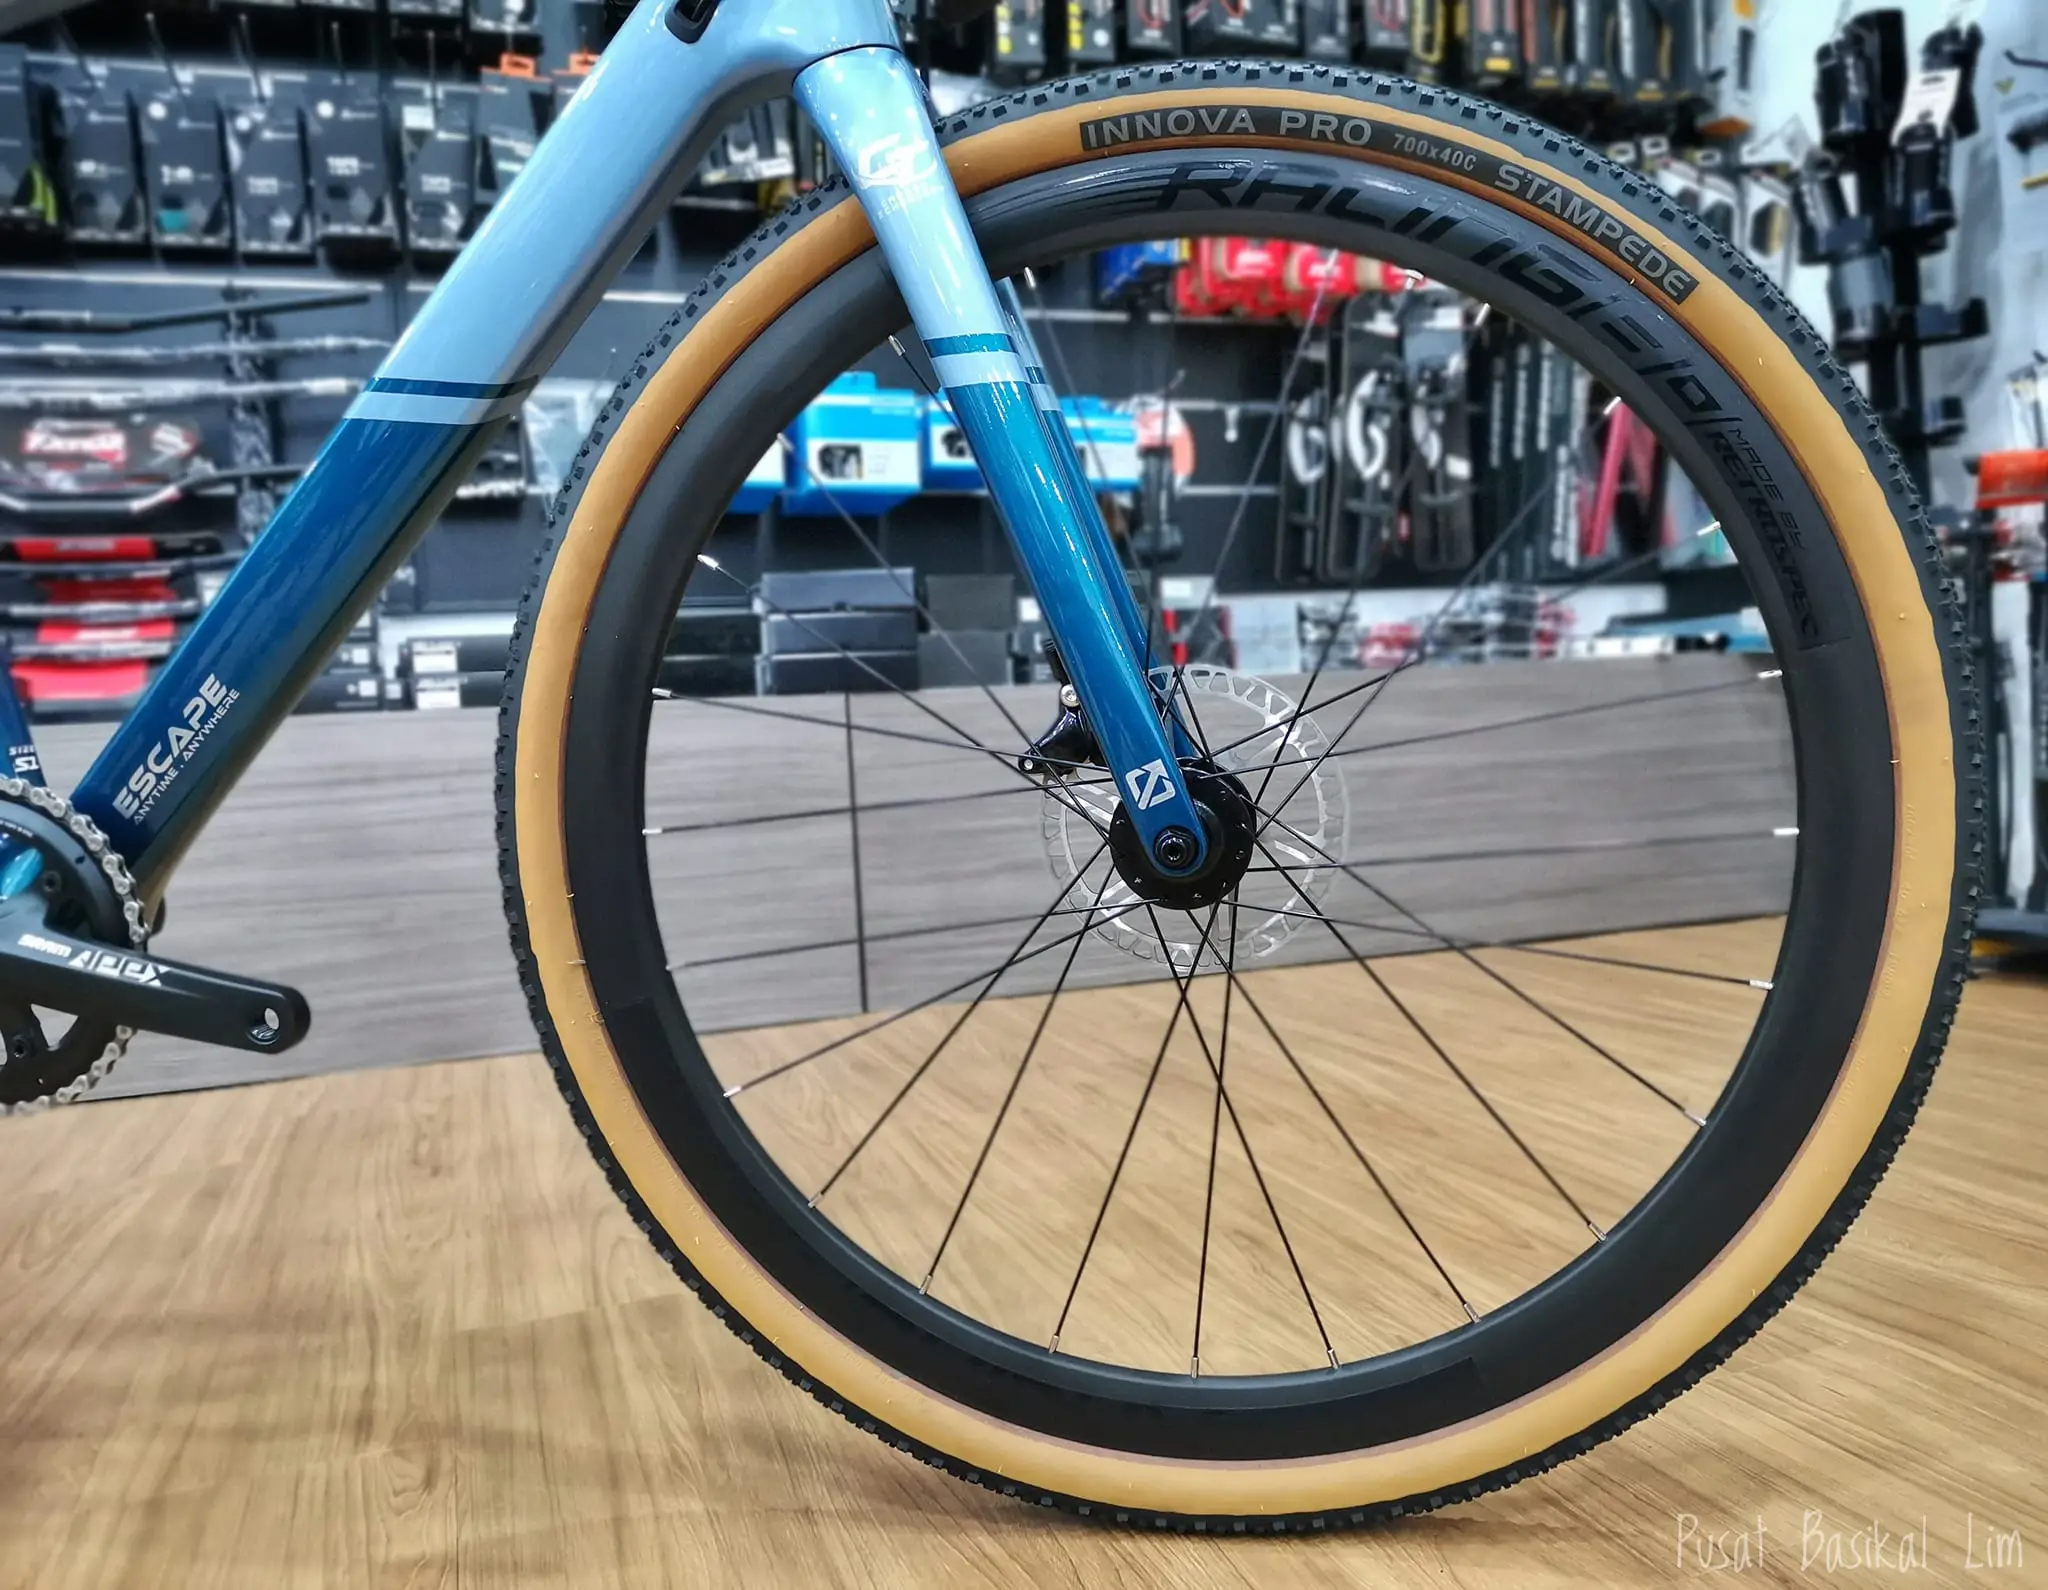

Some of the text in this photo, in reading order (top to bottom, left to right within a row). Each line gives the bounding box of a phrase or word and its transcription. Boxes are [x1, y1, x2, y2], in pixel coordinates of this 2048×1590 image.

[1088, 108, 1693, 297] INNOVA PRO 700x40C STAMPEDE
[112, 673, 228, 819] ESCAPE
[134, 688, 240, 825] ANYTIME ANYWHERE
